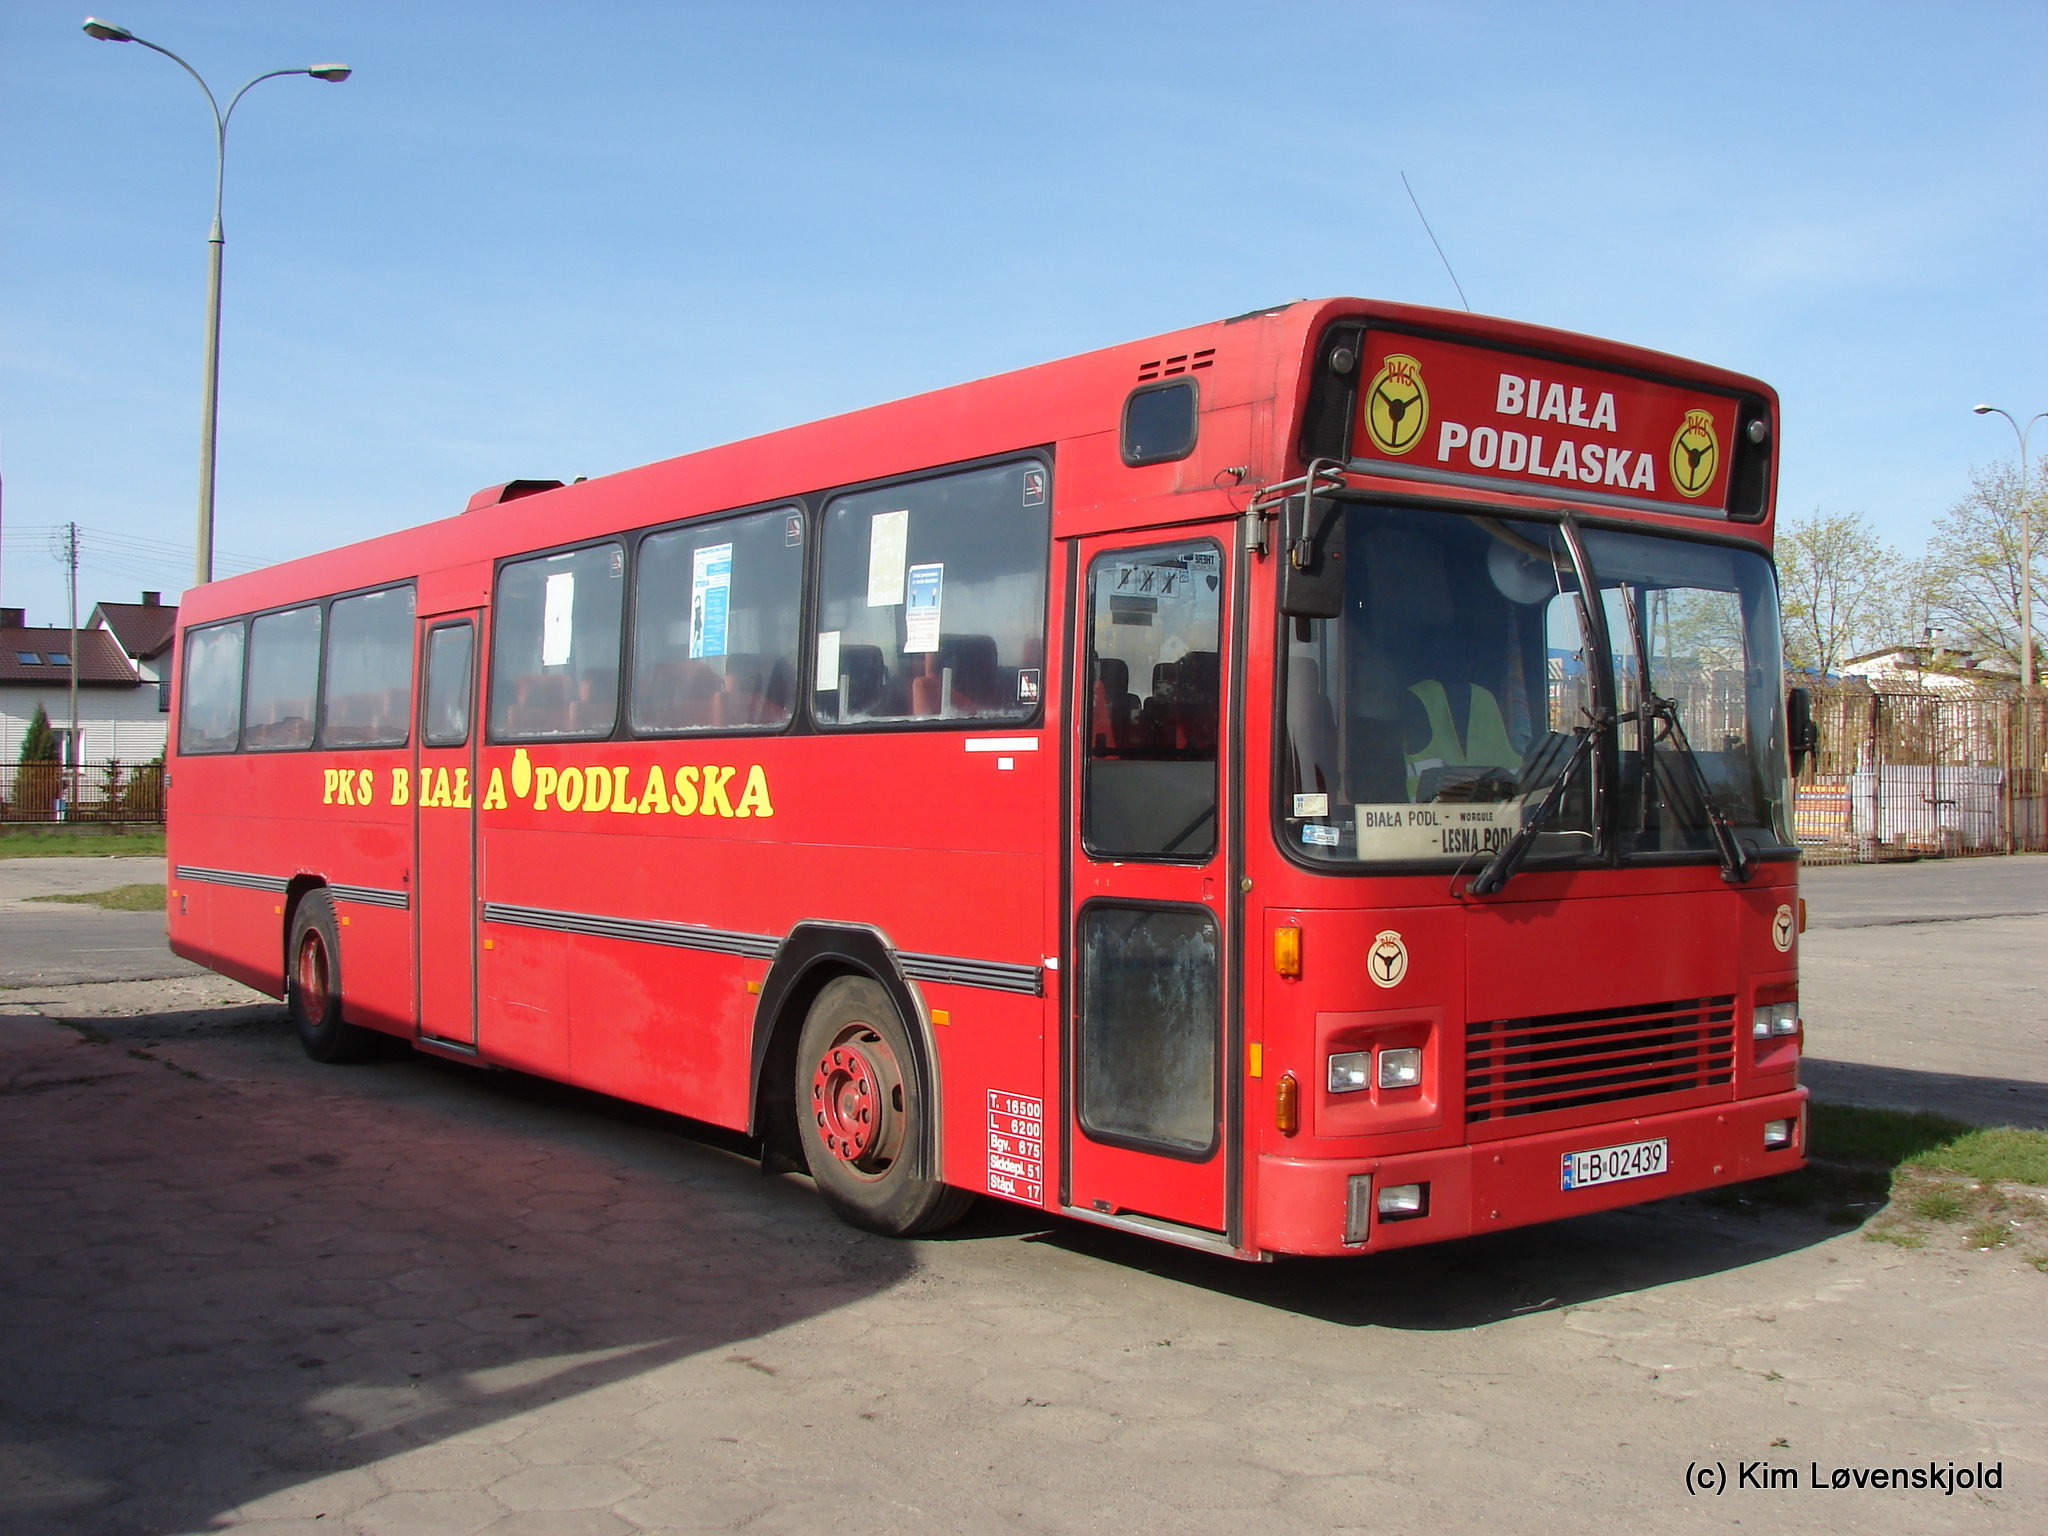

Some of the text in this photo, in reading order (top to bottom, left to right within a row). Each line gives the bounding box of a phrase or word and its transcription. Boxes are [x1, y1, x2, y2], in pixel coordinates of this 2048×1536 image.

[1388, 361, 1416, 386] PKS
[1495, 373, 1618, 432] BIAŁA
[1688, 416, 1709, 437] PKS
[1437, 421, 1655, 492] PODLASKA
[323, 768, 374, 806] PKS
[532, 764, 775, 818] PODLASKA
[1366, 811, 1402, 827] BIAŁA
[1460, 812, 1493, 822] WORGULE
[990, 1093, 1040, 1118] T. 16500
[990, 1113, 1040, 1137] L 6200
[990, 1133, 1040, 1159] Bgv. 675
[1027, 1164, 1040, 1180] 51
[1027, 1184, 1040, 1200] 17
